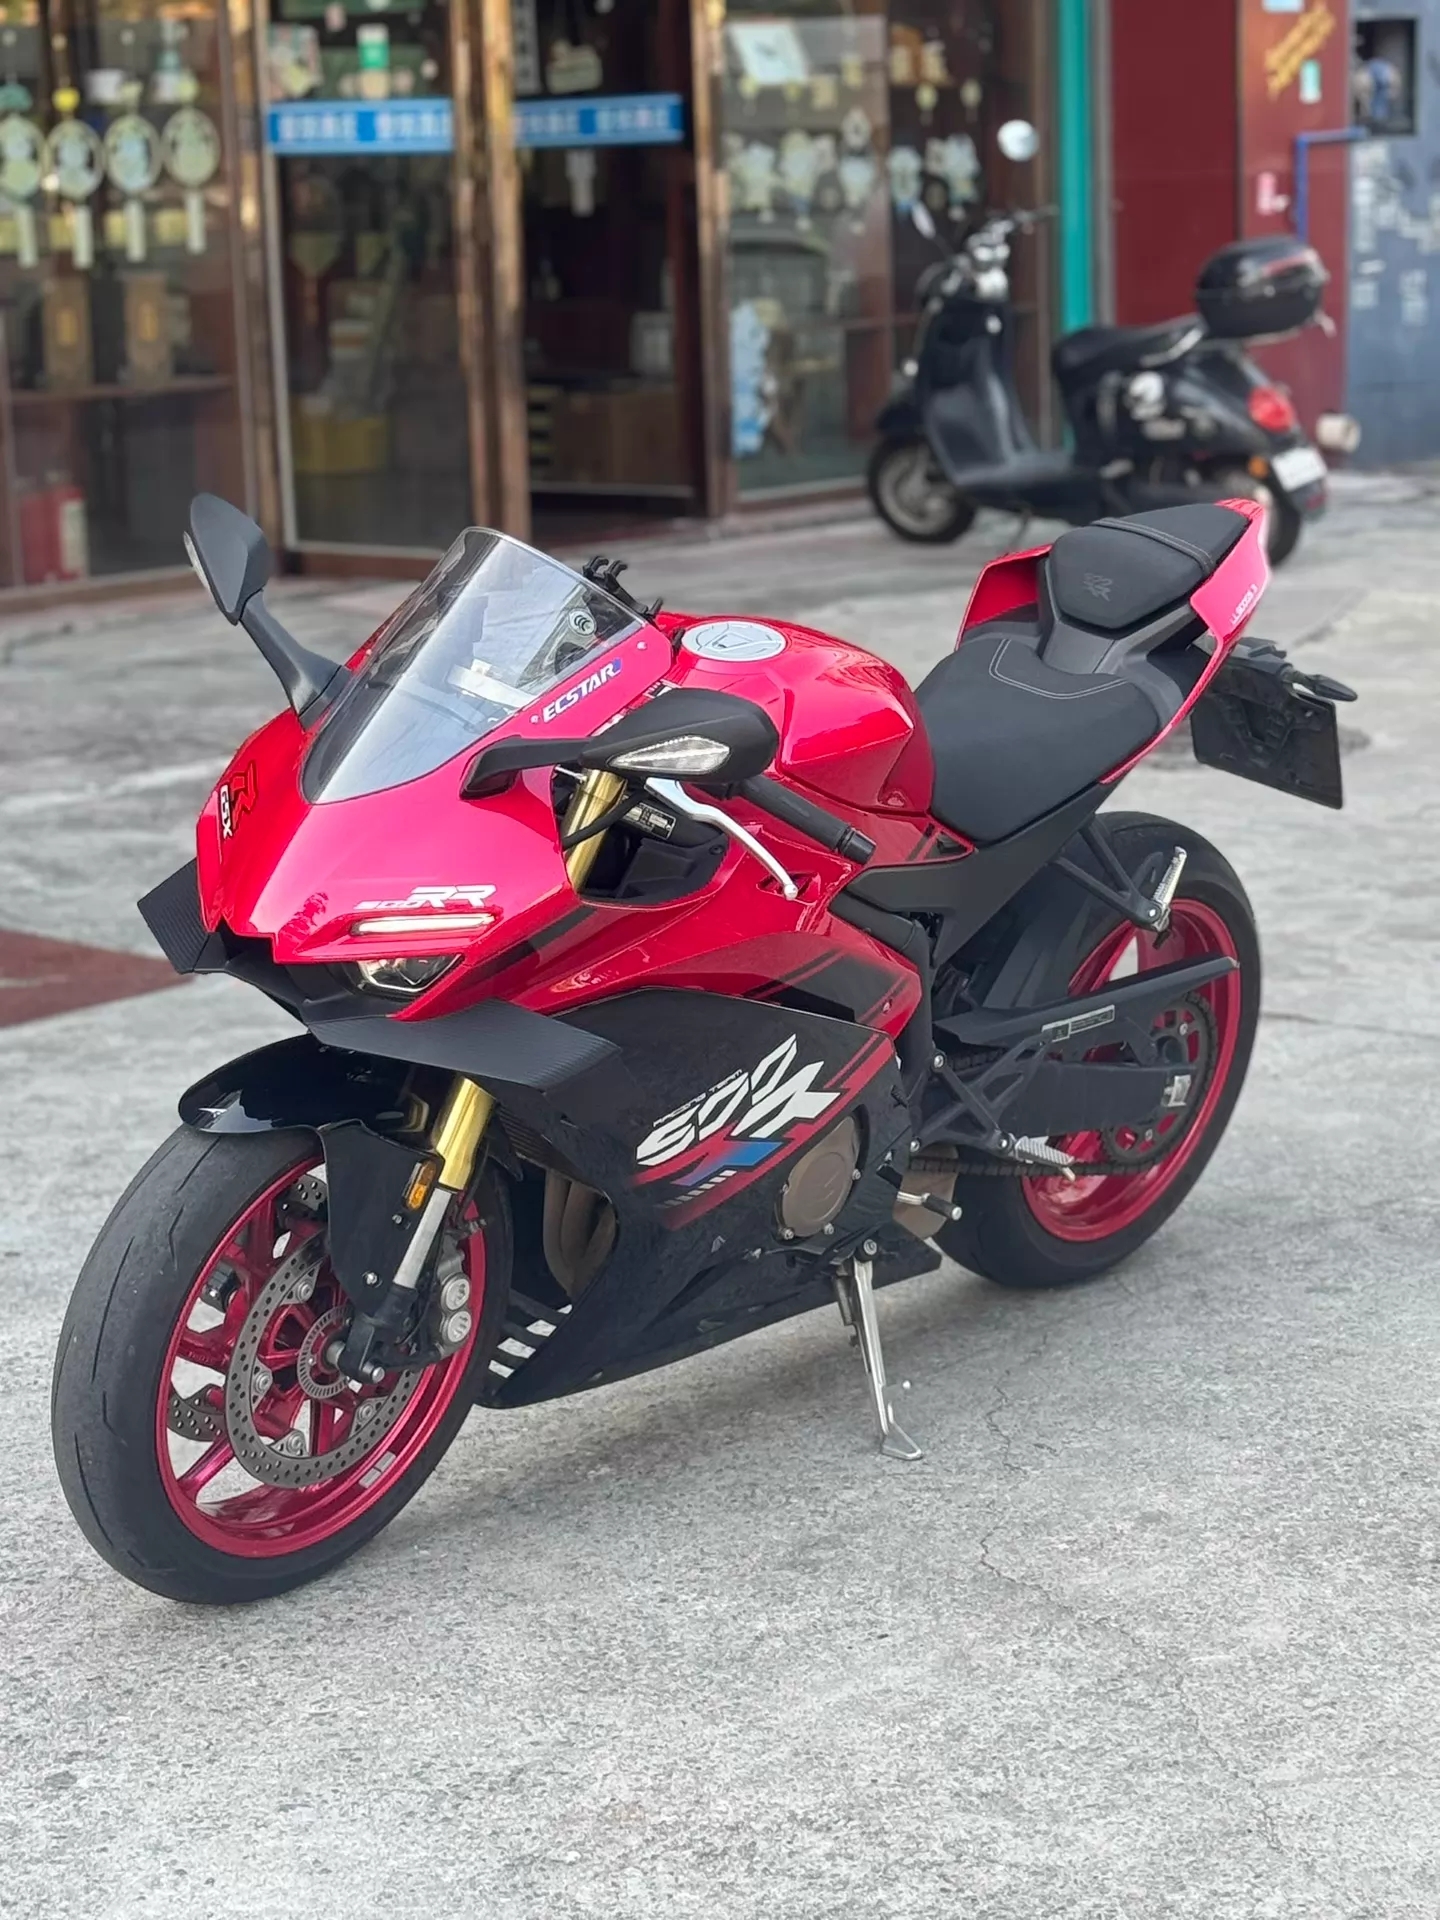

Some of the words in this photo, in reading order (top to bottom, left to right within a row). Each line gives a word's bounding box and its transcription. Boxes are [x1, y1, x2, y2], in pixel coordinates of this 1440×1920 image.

[542, 662, 621, 723] ECSTAR
[219, 783, 233, 840] GSX
[652, 1092, 707, 1128] RACING
